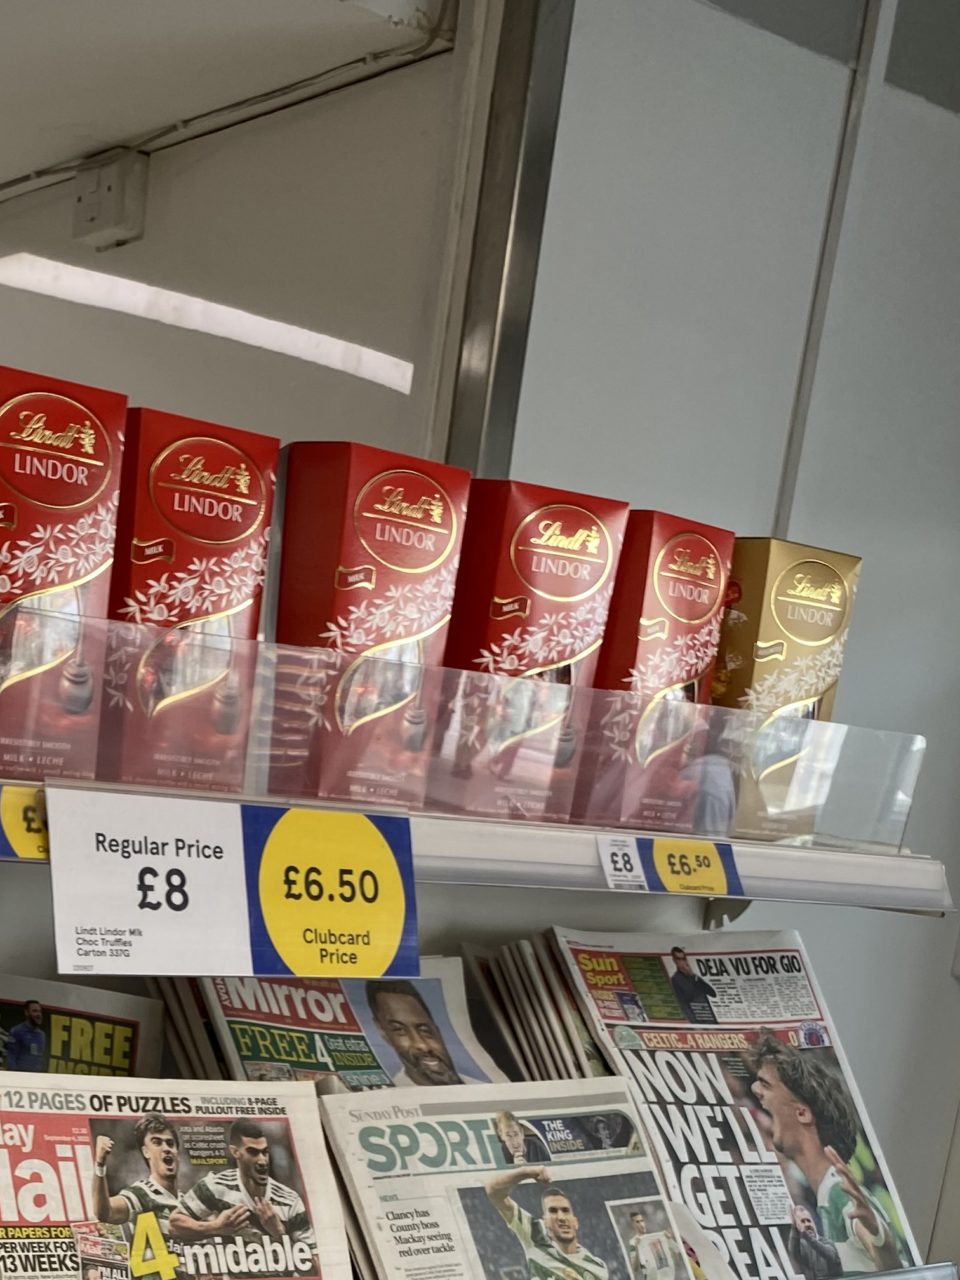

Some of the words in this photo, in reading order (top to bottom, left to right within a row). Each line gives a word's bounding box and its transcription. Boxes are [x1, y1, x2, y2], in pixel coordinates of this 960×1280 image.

[14, 453, 88, 486] LINDOR
[173, 492, 243, 523] LINDOR
[375, 523, 436, 551] LINDOR
[530, 520, 591, 550] Lindt
[531, 556, 591, 580] LINDOR
[668, 584, 710, 605] LINDOR
[786, 605, 833, 628] LINDOR
[3, 753, 25, 762] MILK
[36, 755, 64, 766] LECHE
[95, 832, 169, 860] Regular
[175, 838, 224, 860] Price
[610, 851, 634, 874] £8
[667, 852, 711, 876] £6.50
[136, 866, 189, 912] £8
[283, 865, 379, 905] £6.50
[75, 926, 97, 936] Lindt
[99, 926, 127, 937] Lindor
[129, 928, 143, 937] Mlk
[76, 937, 98, 947] Choc
[101, 937, 132, 948] Truffles
[302, 928, 371, 947] Clubcard
[76, 948, 106, 958] Carton
[109, 949, 130, 958] 337G
[319, 947, 358, 966] Price
[580, 953, 619, 973] Sun
[696, 957, 730, 978] DEJA
[729, 956, 751, 976] VU
[753, 955, 780, 975] FOR
[781, 954, 802, 974] GIO
[587, 972, 625, 987] Sport
[225, 978, 348, 1025] Mirror
[49, 1013, 134, 1070] FREE
[231, 1023, 318, 1064] FREE
[314, 1033, 336, 1072] 4
[333, 1051, 376, 1066] INSIDE
[623, 1050, 735, 1105] NOW
[3, 1090, 27, 1109] 12
[28, 1092, 86, 1111] PAGES
[89, 1094, 116, 1113] OF
[119, 1095, 192, 1115] PUZZLES
[542, 1120, 565, 1131] THE
[544, 1129, 573, 1143] KING
[640, 1104, 779, 1163] WE'LL
[358, 1119, 498, 1173] SPORT
[548, 1139, 585, 1151] INSIDE
[680, 1163, 753, 1228] GET
[385, 1209, 414, 1224] Clancy
[415, 1207, 431, 1219] has
[8, 1226, 50, 1238] PAPERS
[51, 1226, 72, 1238] FOR
[17, 1252, 81, 1273] WEEKS
